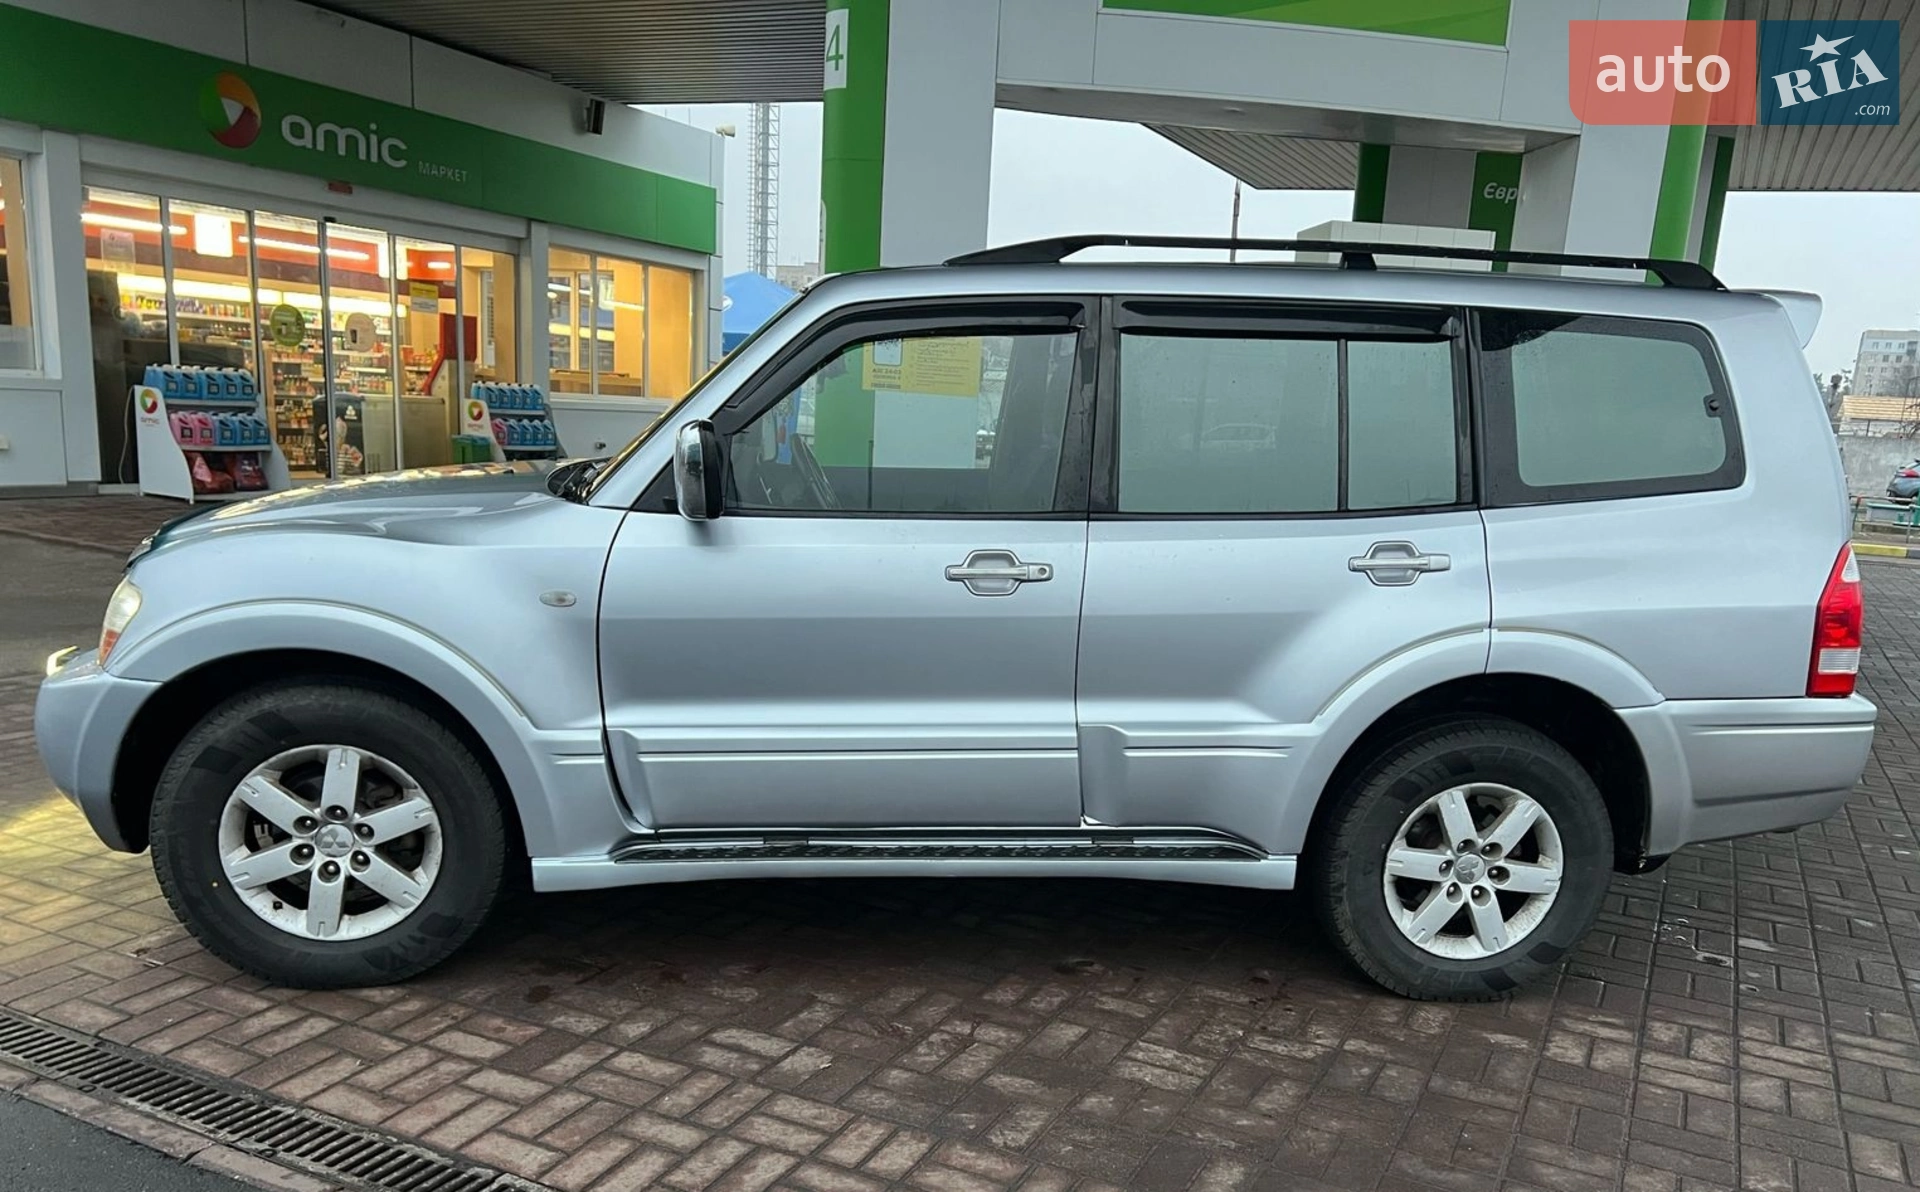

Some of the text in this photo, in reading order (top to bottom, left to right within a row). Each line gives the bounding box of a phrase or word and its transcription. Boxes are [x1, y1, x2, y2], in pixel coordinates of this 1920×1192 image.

[825, 24, 844, 71] 4
[281, 114, 408, 168] amic
[418, 160, 468, 183] МАРКЕТ
